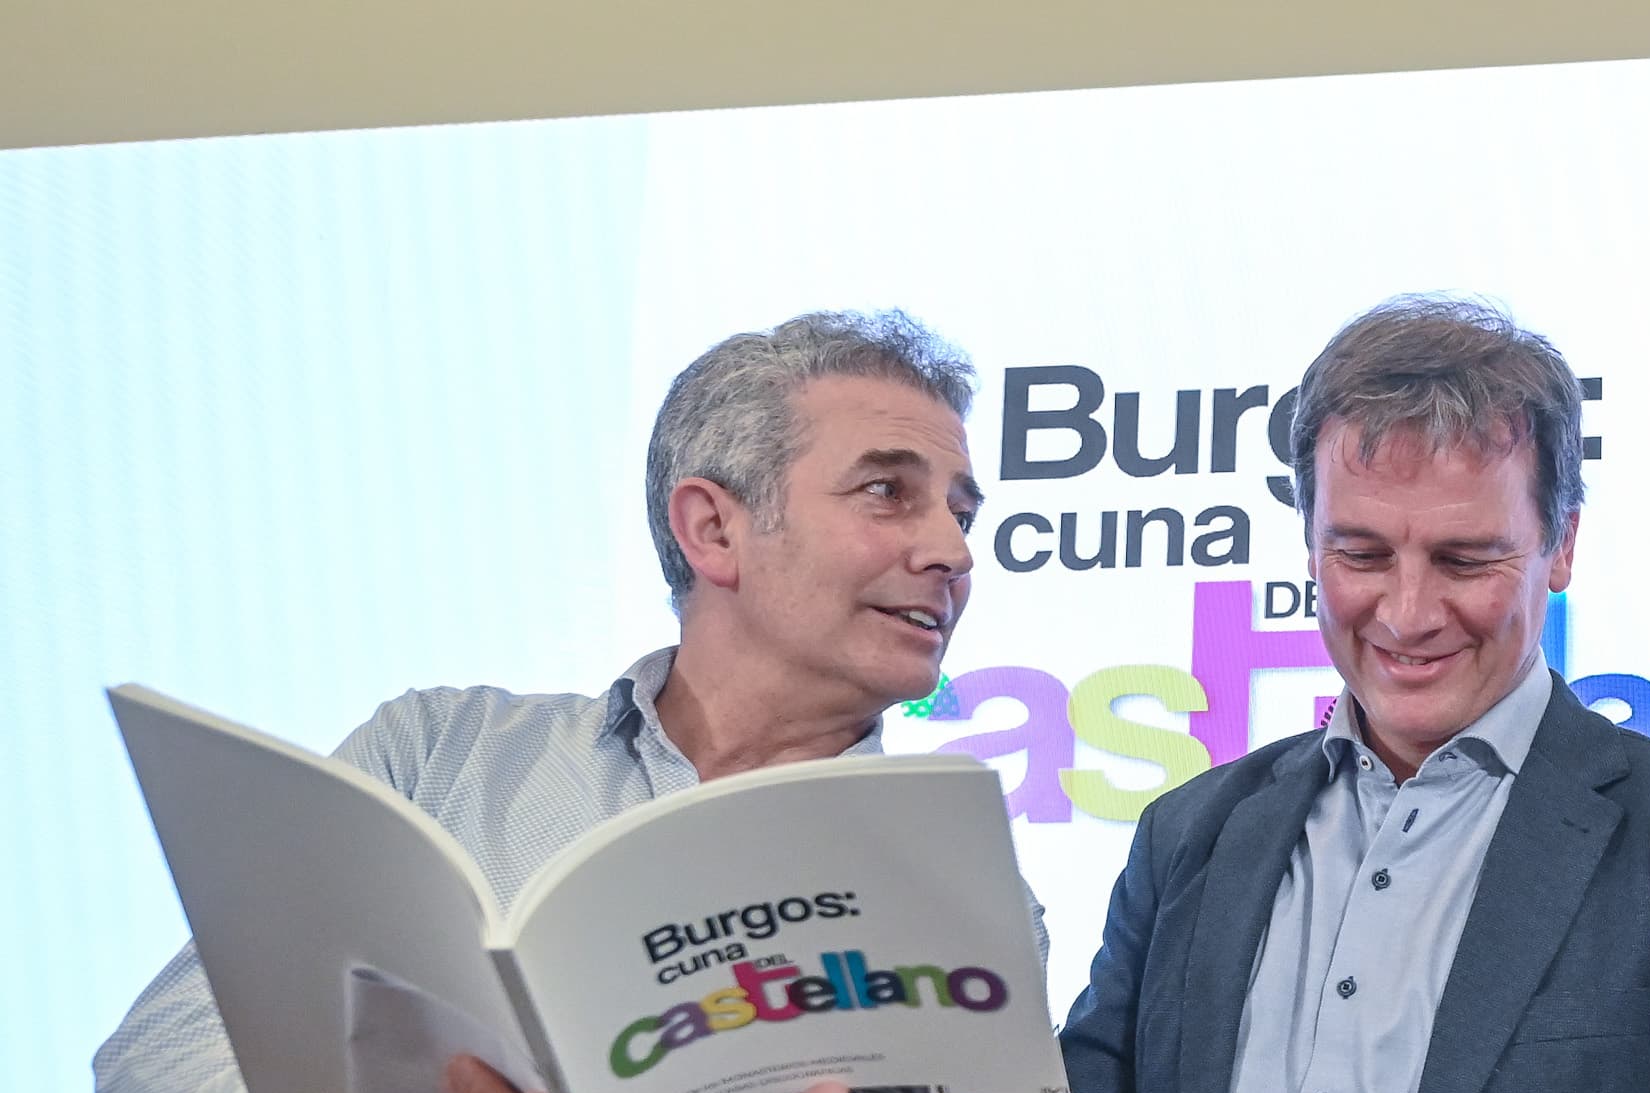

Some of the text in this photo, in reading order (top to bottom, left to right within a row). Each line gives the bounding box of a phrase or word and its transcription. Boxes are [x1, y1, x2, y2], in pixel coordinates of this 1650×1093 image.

[993, 503, 1251, 573] cuna
[642, 890, 861, 965] Burgos:
[657, 941, 748, 985] cuna
[609, 949, 1009, 1080] castellano
